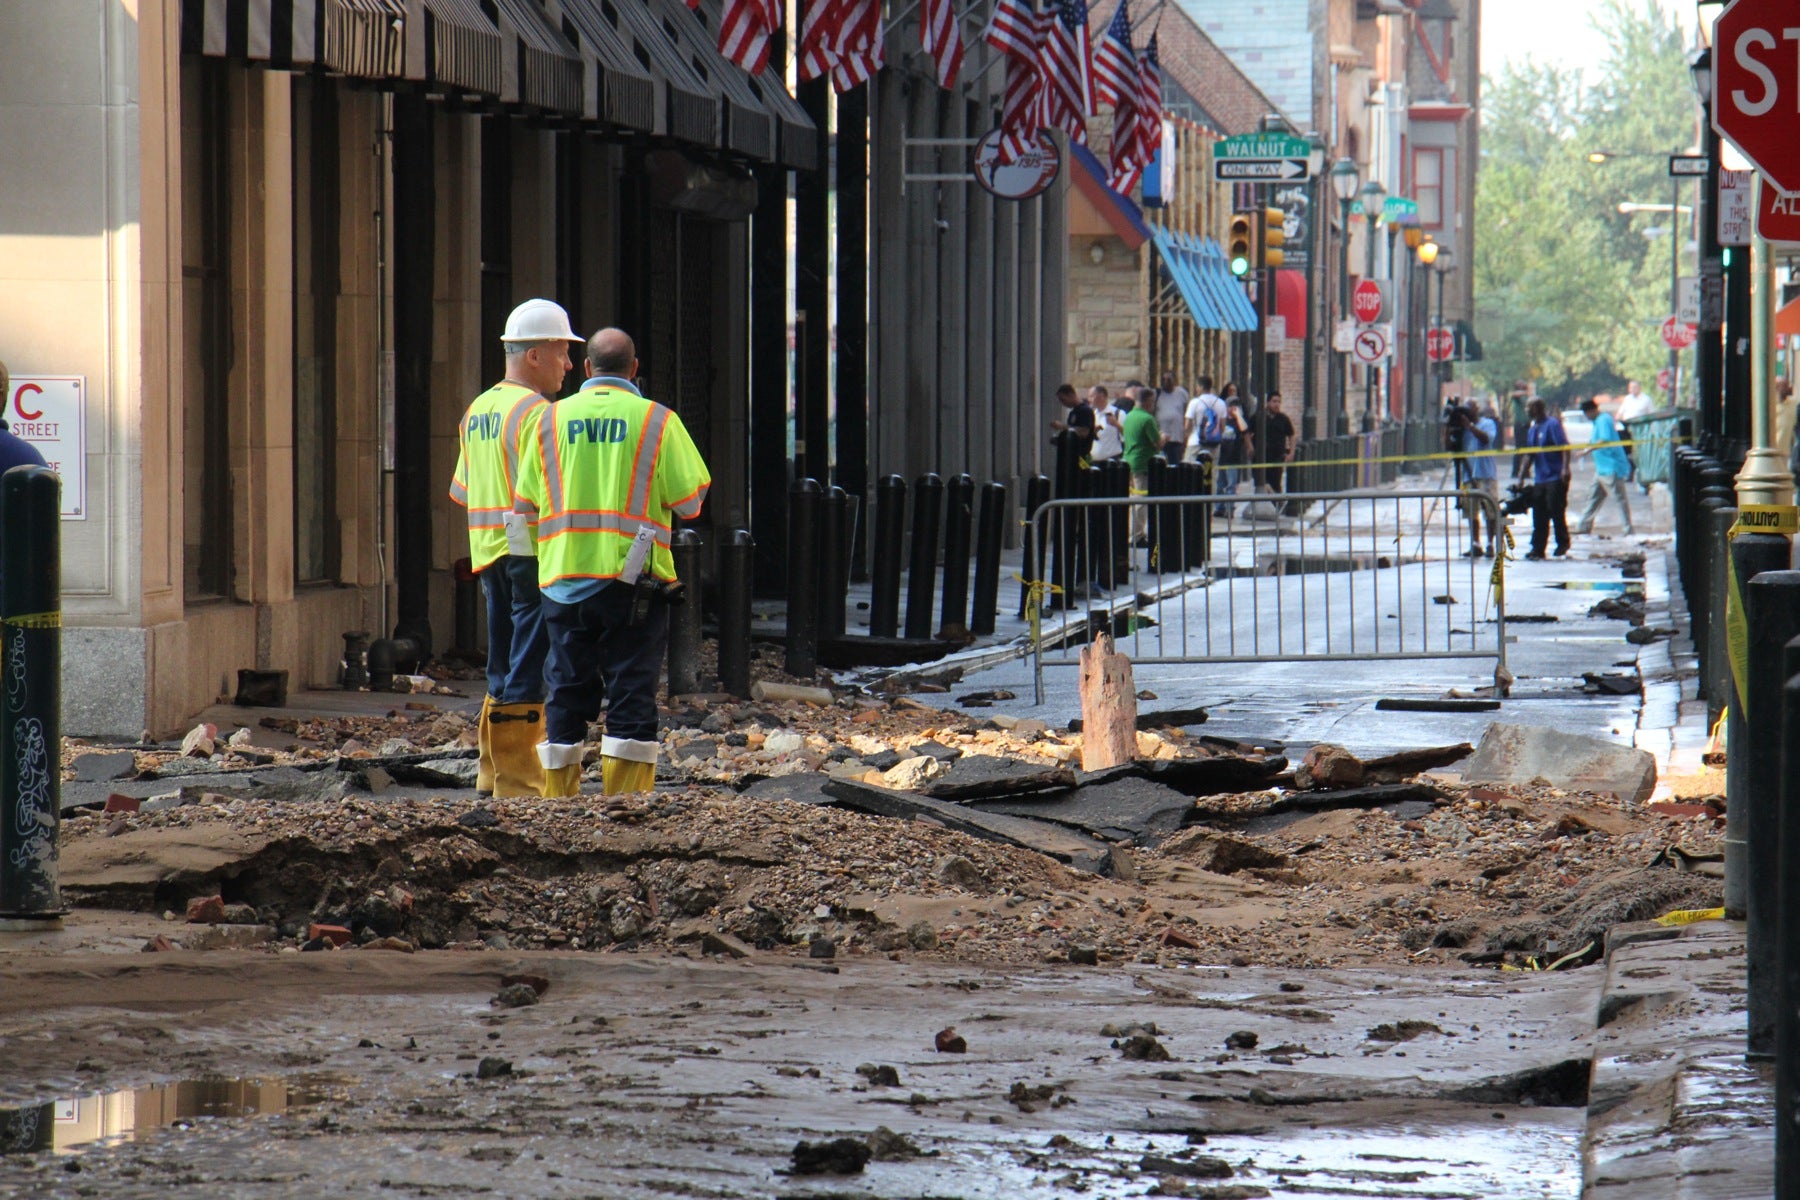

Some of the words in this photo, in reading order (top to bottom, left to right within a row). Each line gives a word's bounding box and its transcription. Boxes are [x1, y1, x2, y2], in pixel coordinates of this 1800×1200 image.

[1226, 142, 1286, 156] WALNUT
[1292, 146, 1303, 155] ST
[1226, 165, 1249, 175] ONE
[1255, 165, 1282, 175] WAY
[1721, 170, 1736, 188] NO
[1735, 193, 1743, 203] IN
[1356, 292, 1380, 310] STOP
[1682, 309, 1696, 318] ON
[14, 383, 43, 420] C
[13, 423, 59, 436] STREET
[468, 412, 502, 442] PWD
[568, 418, 627, 444] PWD
